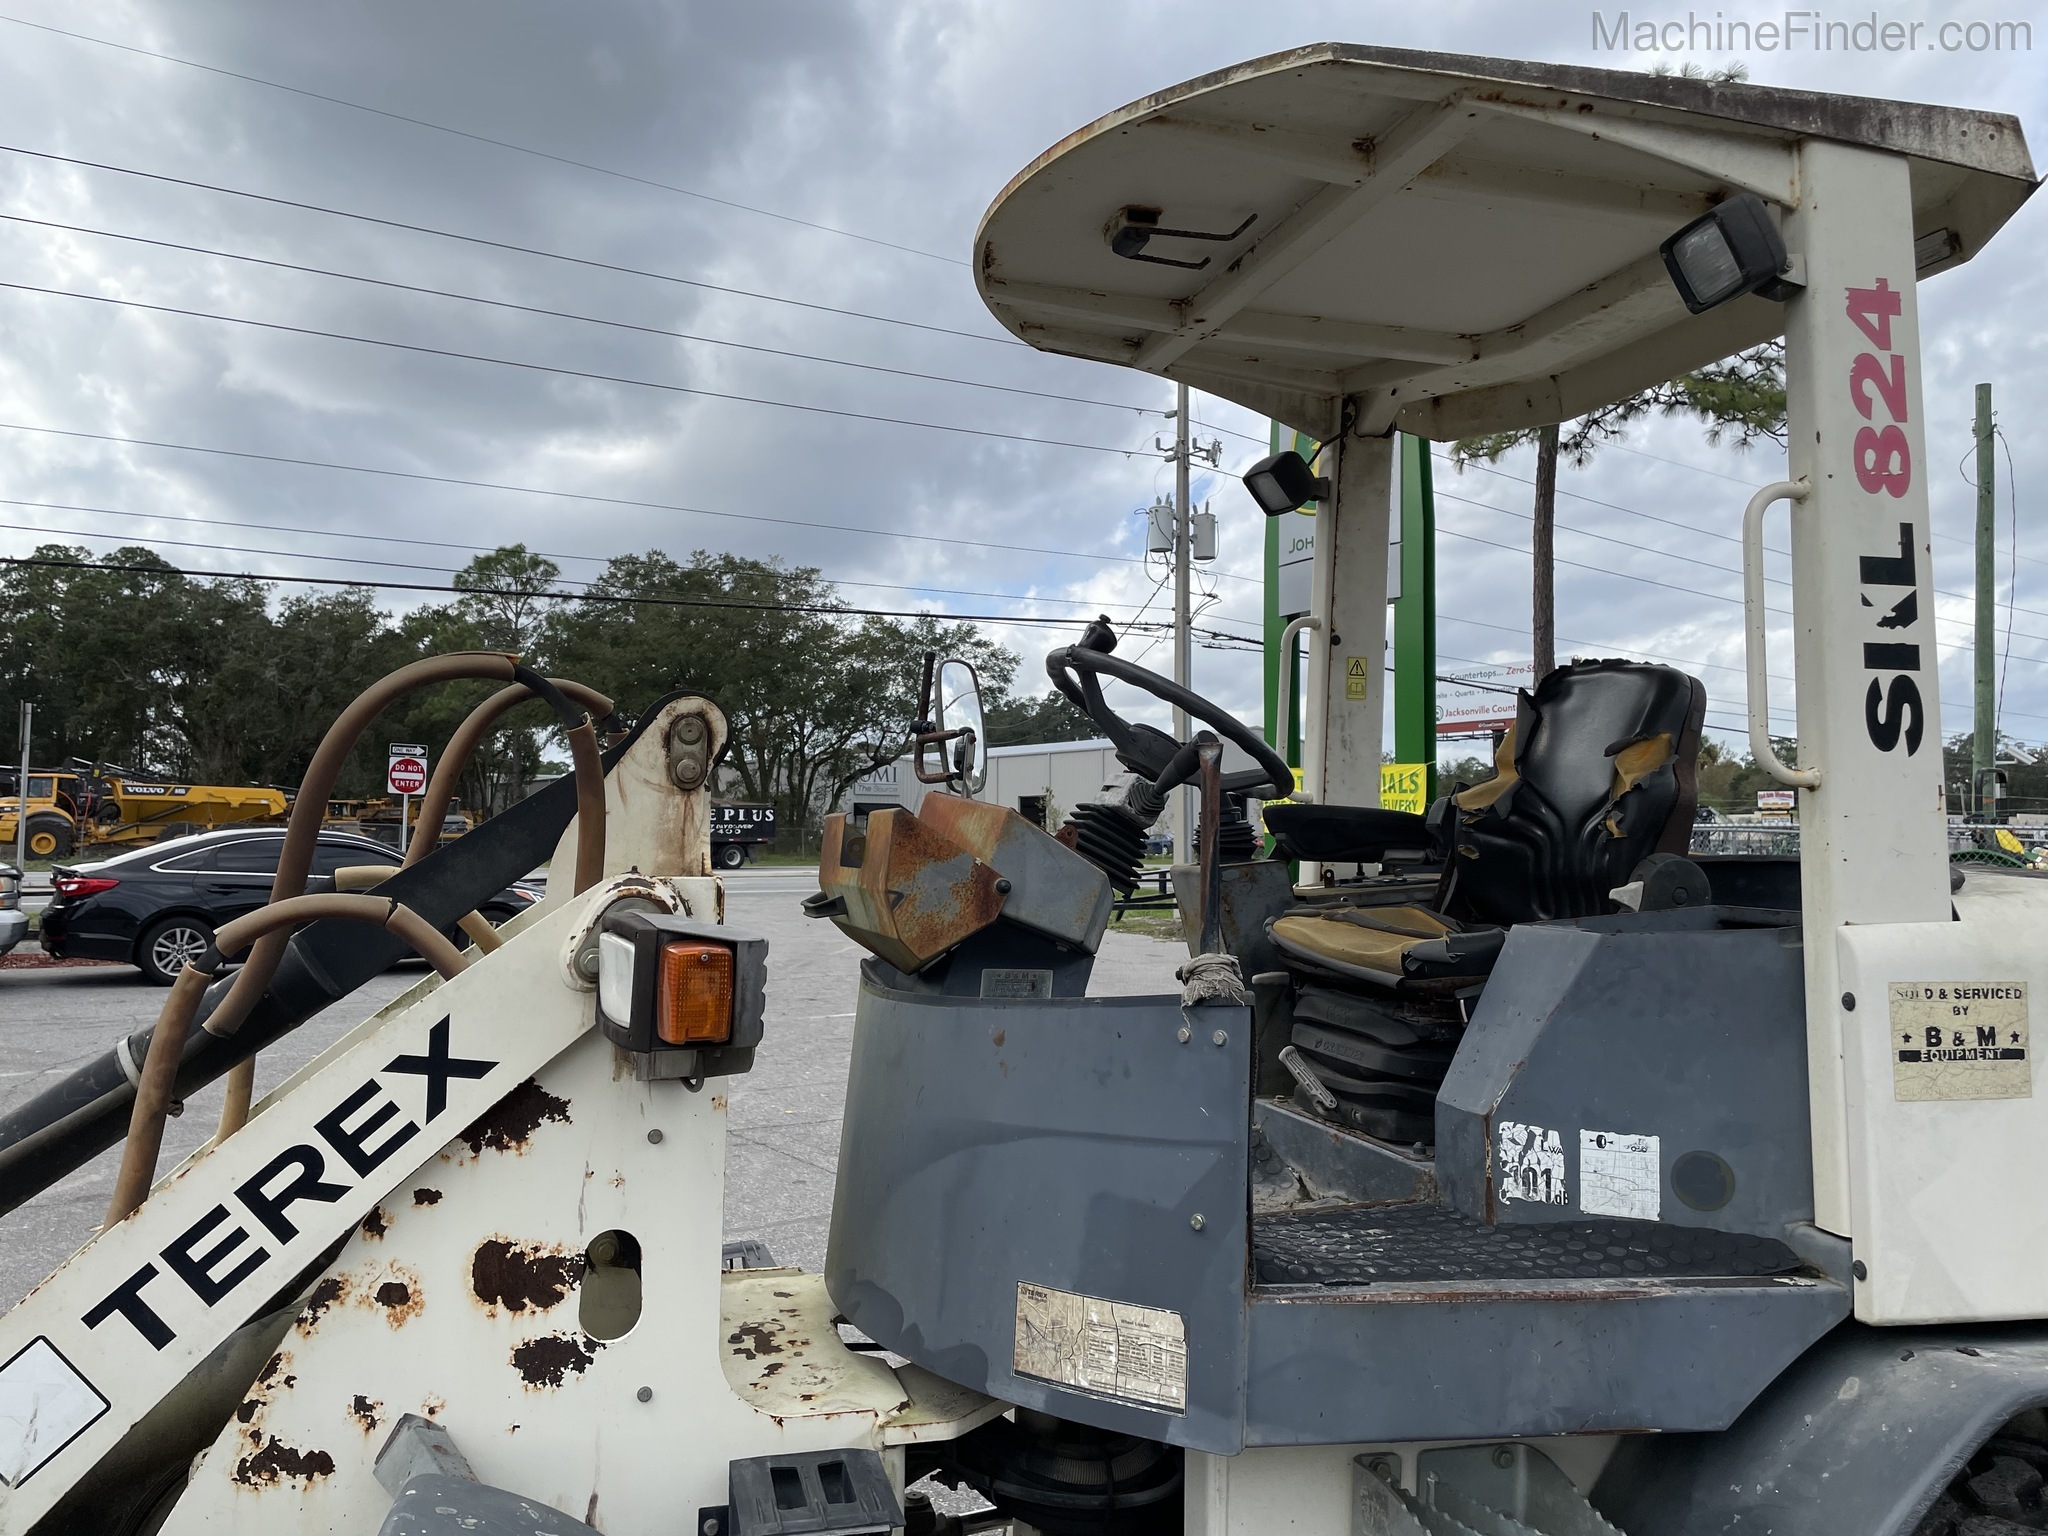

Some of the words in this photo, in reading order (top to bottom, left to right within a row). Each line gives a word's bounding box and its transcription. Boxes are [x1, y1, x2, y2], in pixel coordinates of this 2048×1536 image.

[1845, 277, 1910, 499] 824
[1506, 666, 1524, 675] Zero
[1455, 690, 1475, 698] Quartz
[1445, 705, 1490, 717] Jacksonville
[1491, 703, 1516, 713] Count
[126, 786, 165, 794] VOLVO
[395, 780, 420, 788] ENTER
[723, 809, 775, 822] PLUS
[1938, 988, 1948, 999] &
[1953, 987, 2022, 999] SERVICED
[1953, 1006, 1969, 1015] BY
[1925, 1026, 1942, 1047] B
[1952, 1031, 1966, 1046] &
[1976, 1026, 1997, 1046] M
[1921, 1049, 2002, 1061] EQUIPMENT
[80, 1013, 500, 1352] TEREX
[1509, 1166, 1552, 1204] 101
[1028, 1289, 1047, 1299] TEREX
